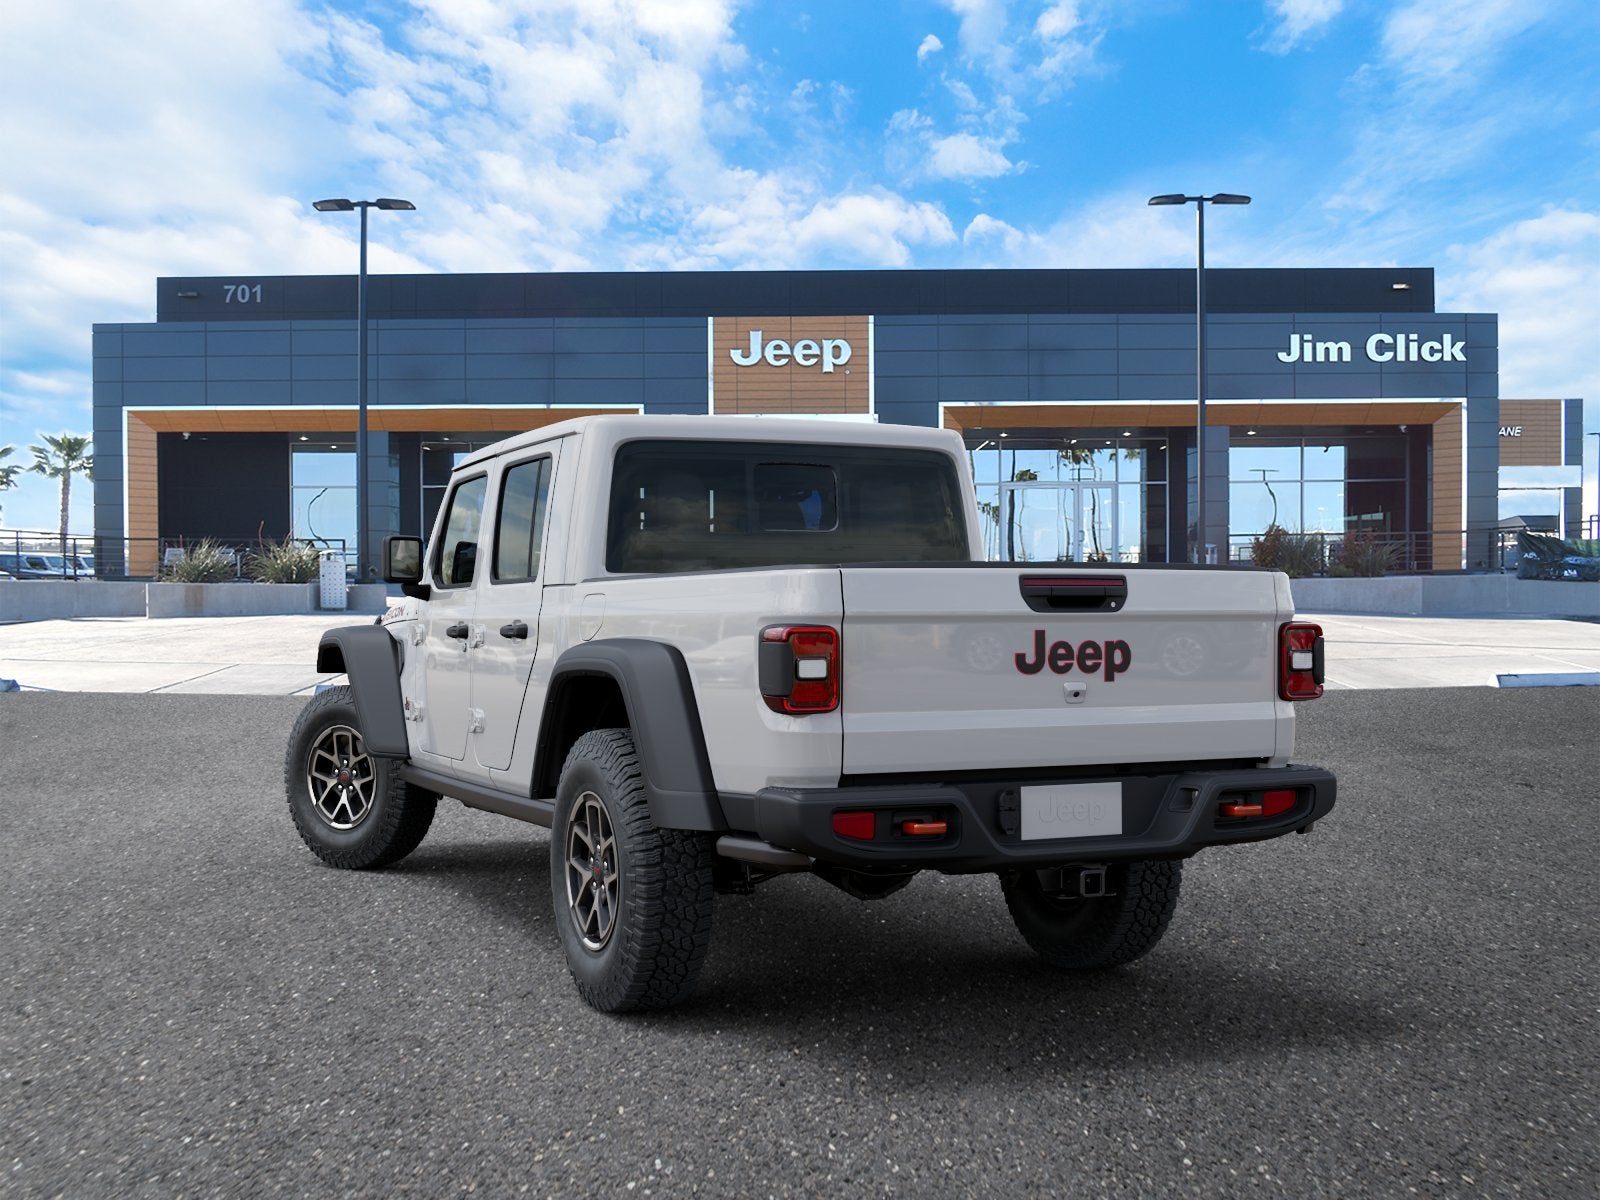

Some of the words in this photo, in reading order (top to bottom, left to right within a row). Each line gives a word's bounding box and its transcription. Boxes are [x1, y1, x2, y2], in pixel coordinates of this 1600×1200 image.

[223, 284, 262, 304] 701
[729, 330, 852, 373] Jeep
[1277, 334, 1351, 362] Jim
[1366, 333, 1467, 362] Click
[1014, 629, 1132, 682] Jeep
[1037, 791, 1105, 827] Jeep
